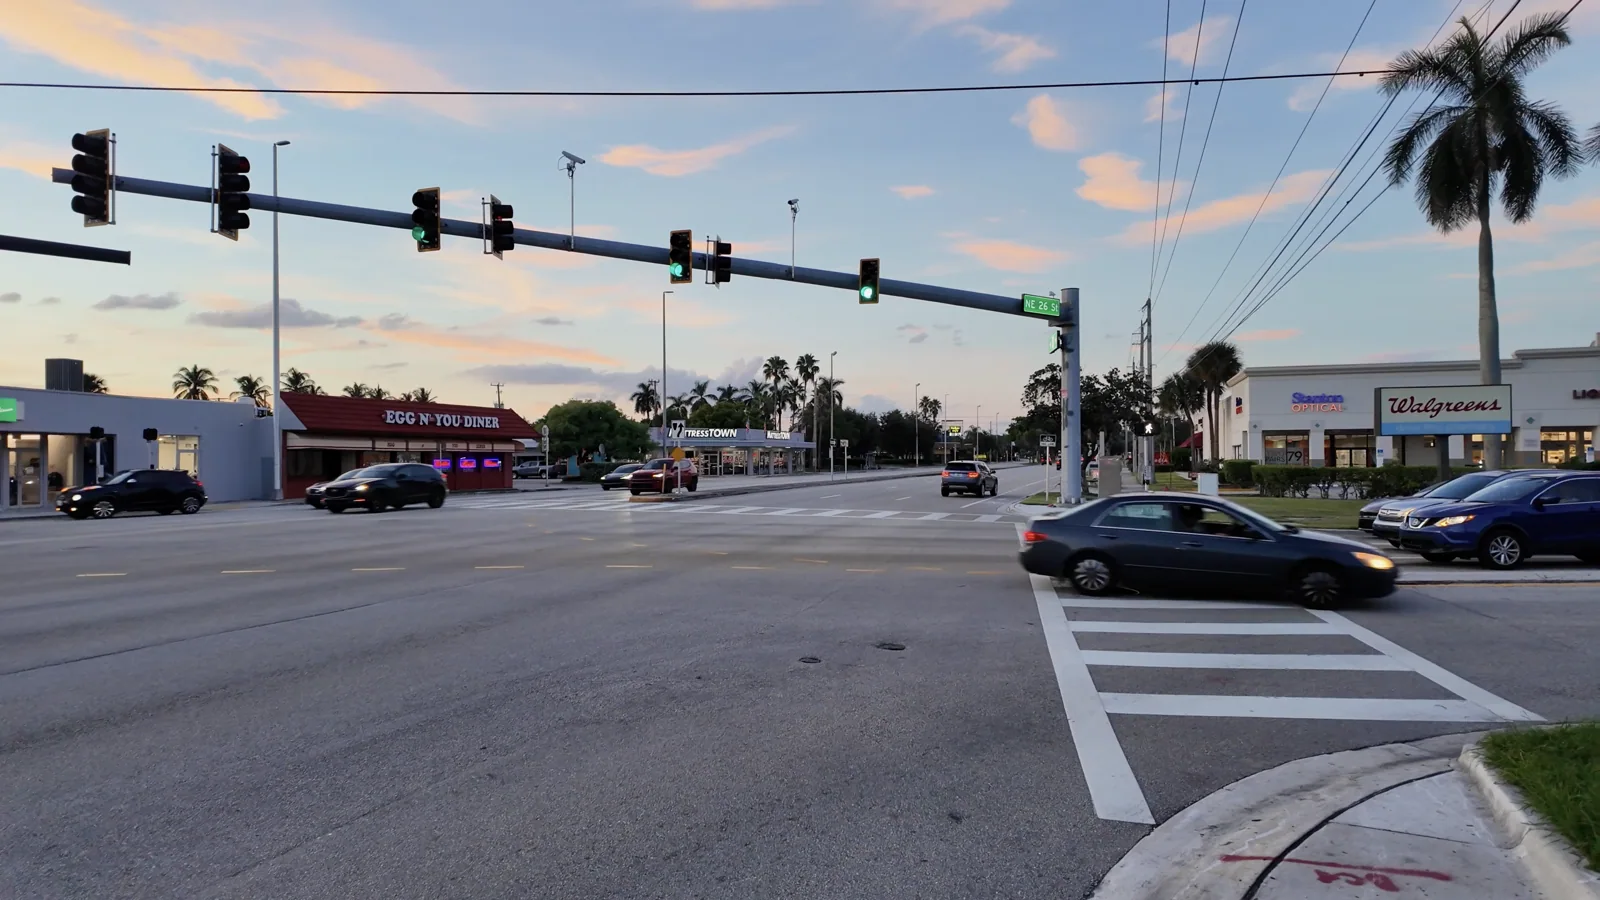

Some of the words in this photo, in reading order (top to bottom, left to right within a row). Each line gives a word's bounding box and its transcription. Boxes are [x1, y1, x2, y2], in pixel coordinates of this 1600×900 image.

[1025, 299, 1036, 309] NE
[1038, 301, 1048, 311] 26
[1051, 303, 1059, 312] St
[1291, 392, 1344, 404] Stanton
[1572, 388, 1600, 400] LIQ
[1291, 403, 1344, 413] OPTICAL
[1388, 396, 1502, 419] Walgreens
[385, 409, 416, 425] EGG
[434, 413, 461, 428] YOU
[463, 415, 500, 429] DINER
[668, 428, 737, 438] TTRESSTOWN
